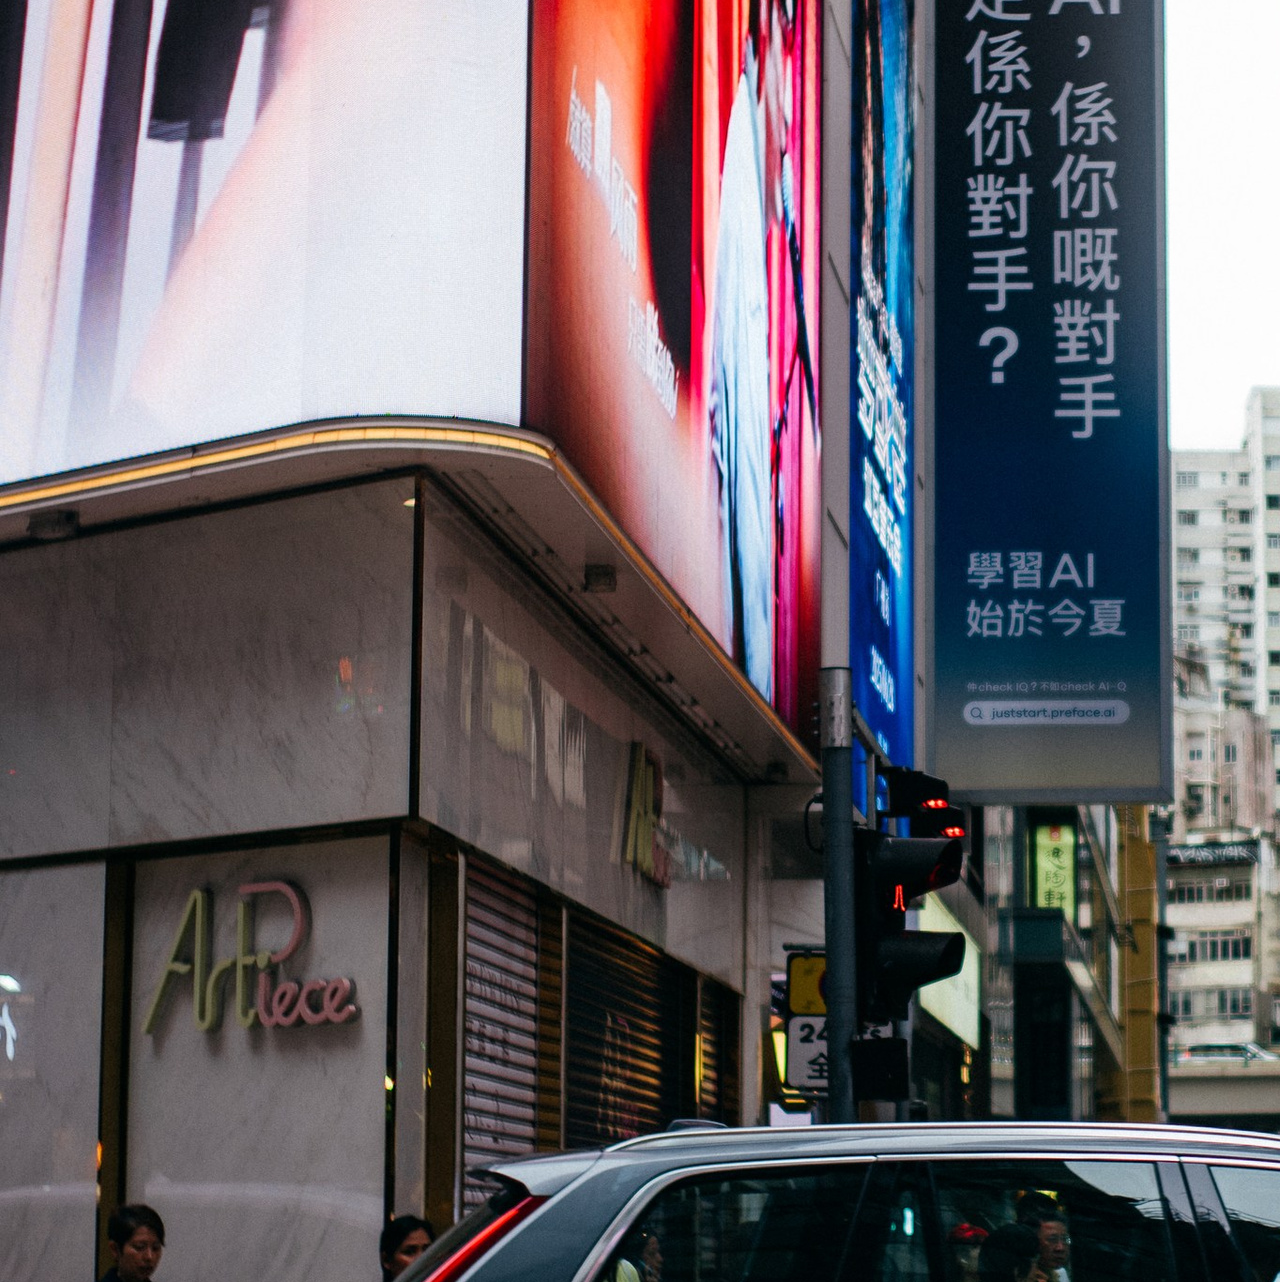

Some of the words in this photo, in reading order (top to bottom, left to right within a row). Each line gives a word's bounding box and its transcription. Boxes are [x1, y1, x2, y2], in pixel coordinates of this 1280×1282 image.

[966, 551, 1095, 590] 學習AI
[966, 598, 1127, 638] 始於今夏
[991, 707, 1116, 720] juststart.preface.ai
